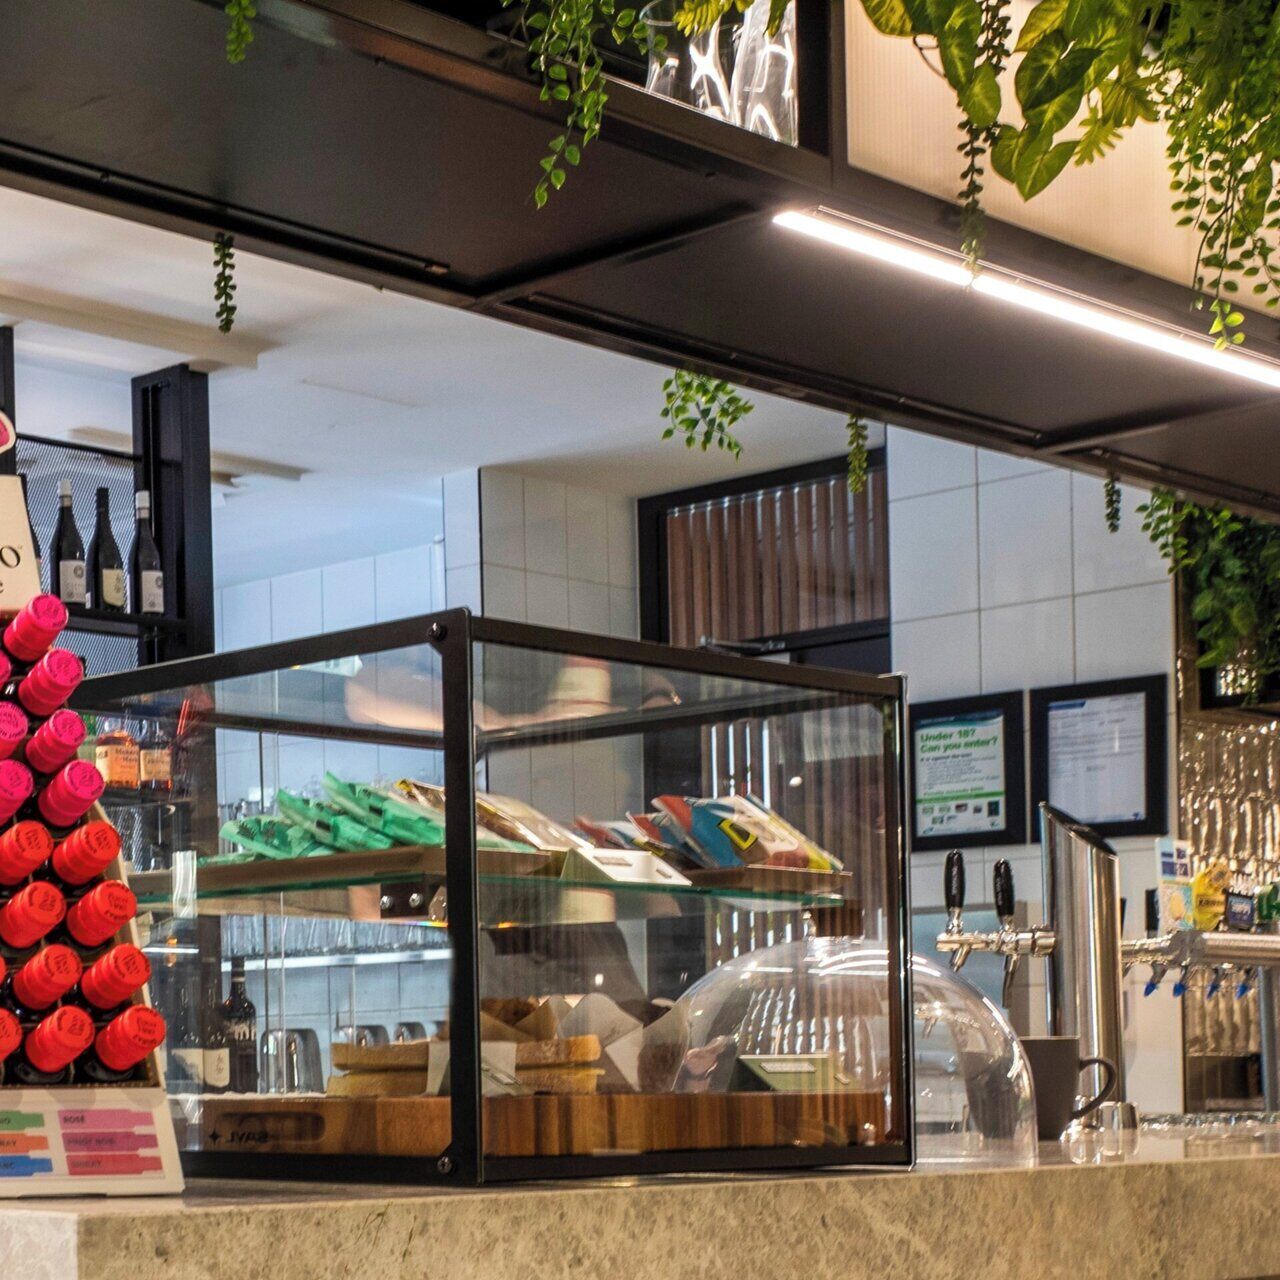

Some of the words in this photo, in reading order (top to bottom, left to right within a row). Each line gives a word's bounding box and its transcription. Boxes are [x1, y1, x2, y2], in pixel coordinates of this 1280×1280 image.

[921, 732, 953, 741] Under
[958, 729, 976, 738] 18?
[920, 744, 940, 753] Can
[943, 743, 961, 752] you
[964, 736, 998, 748] enter?
